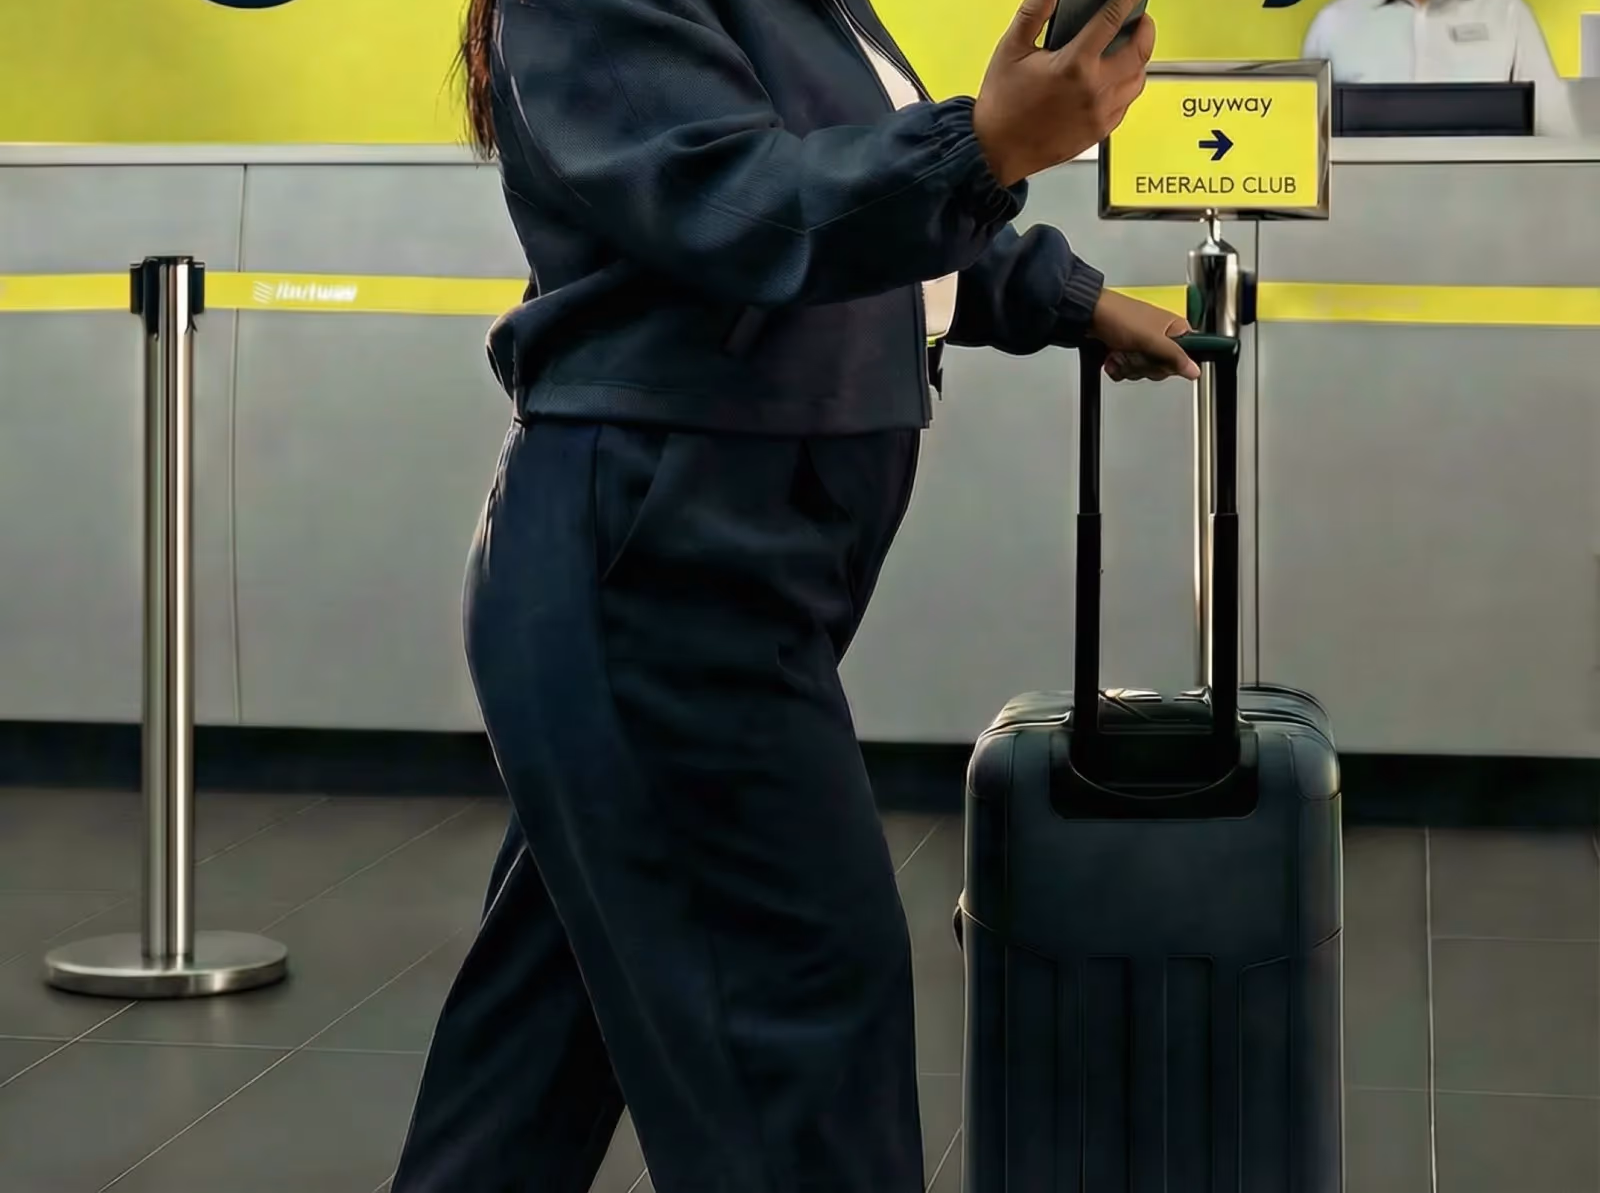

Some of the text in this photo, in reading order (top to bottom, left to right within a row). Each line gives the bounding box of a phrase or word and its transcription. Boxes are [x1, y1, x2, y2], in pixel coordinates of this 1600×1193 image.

[1182, 97, 1273, 118] guyway
[1135, 176, 1297, 194] EMERALD CLUB
